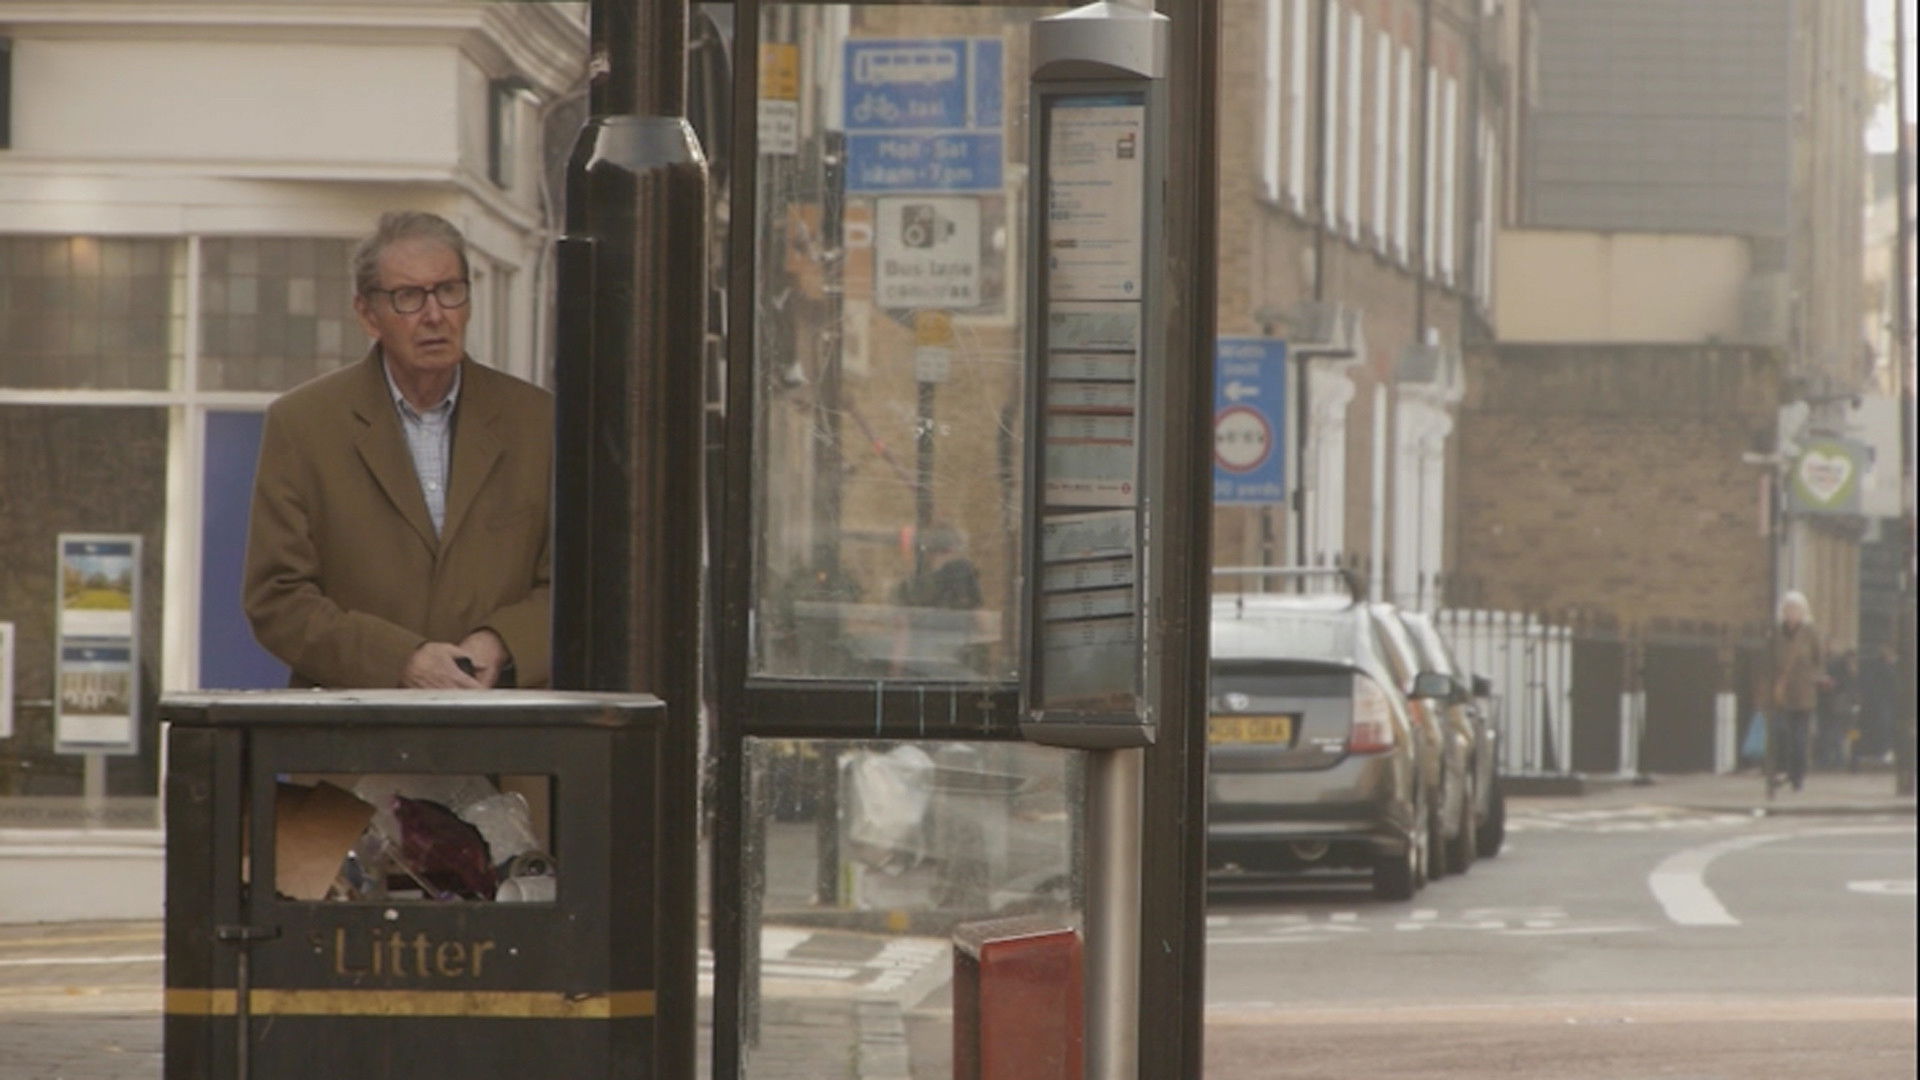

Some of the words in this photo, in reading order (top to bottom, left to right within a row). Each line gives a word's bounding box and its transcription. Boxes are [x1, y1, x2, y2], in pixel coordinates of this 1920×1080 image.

[934, 140, 967, 159] Sat
[885, 260, 922, 277] Bus
[929, 260, 971, 277] lane
[885, 284, 970, 300] cameras
[334, 927, 495, 978] Litter
